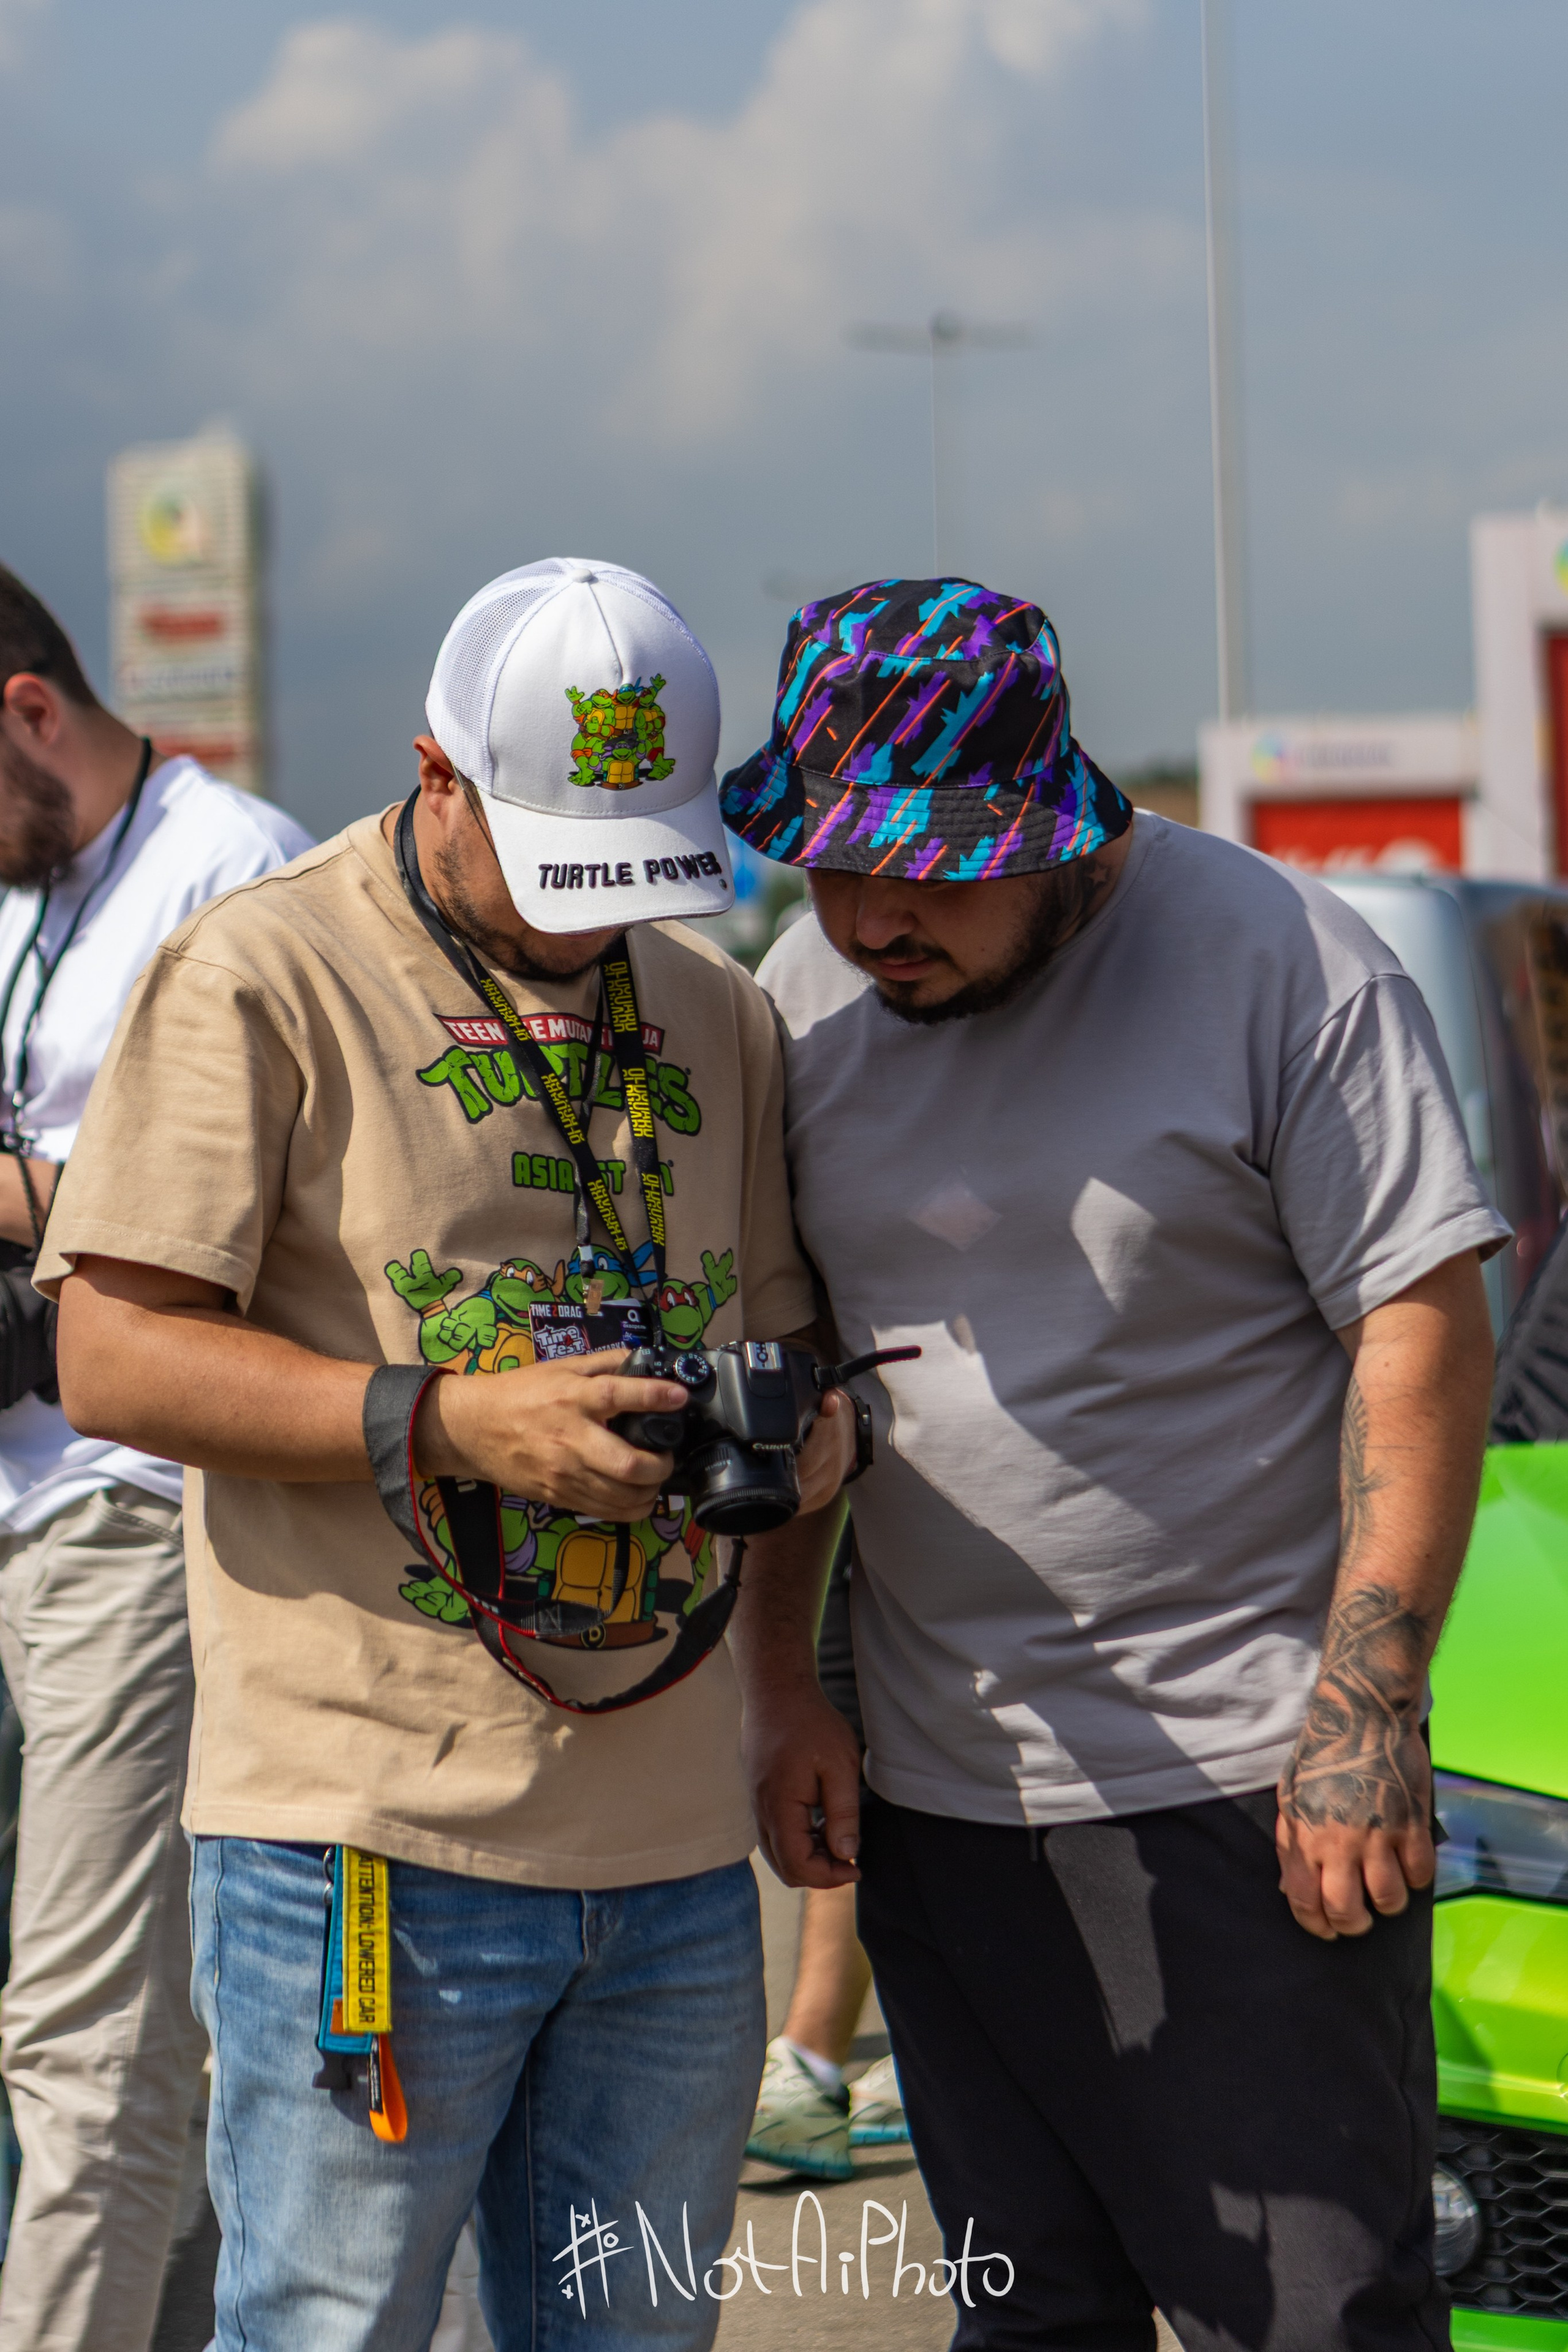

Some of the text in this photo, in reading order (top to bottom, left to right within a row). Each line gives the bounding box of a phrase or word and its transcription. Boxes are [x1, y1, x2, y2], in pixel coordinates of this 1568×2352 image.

[539, 851, 723, 889] TURTLE POWER
[445, 1019, 548, 1041] TEENE
[512, 1152, 575, 1193] ASIA
[358, 1932, 375, 1992] LOWERED
[358, 1998, 375, 2023] CAR
